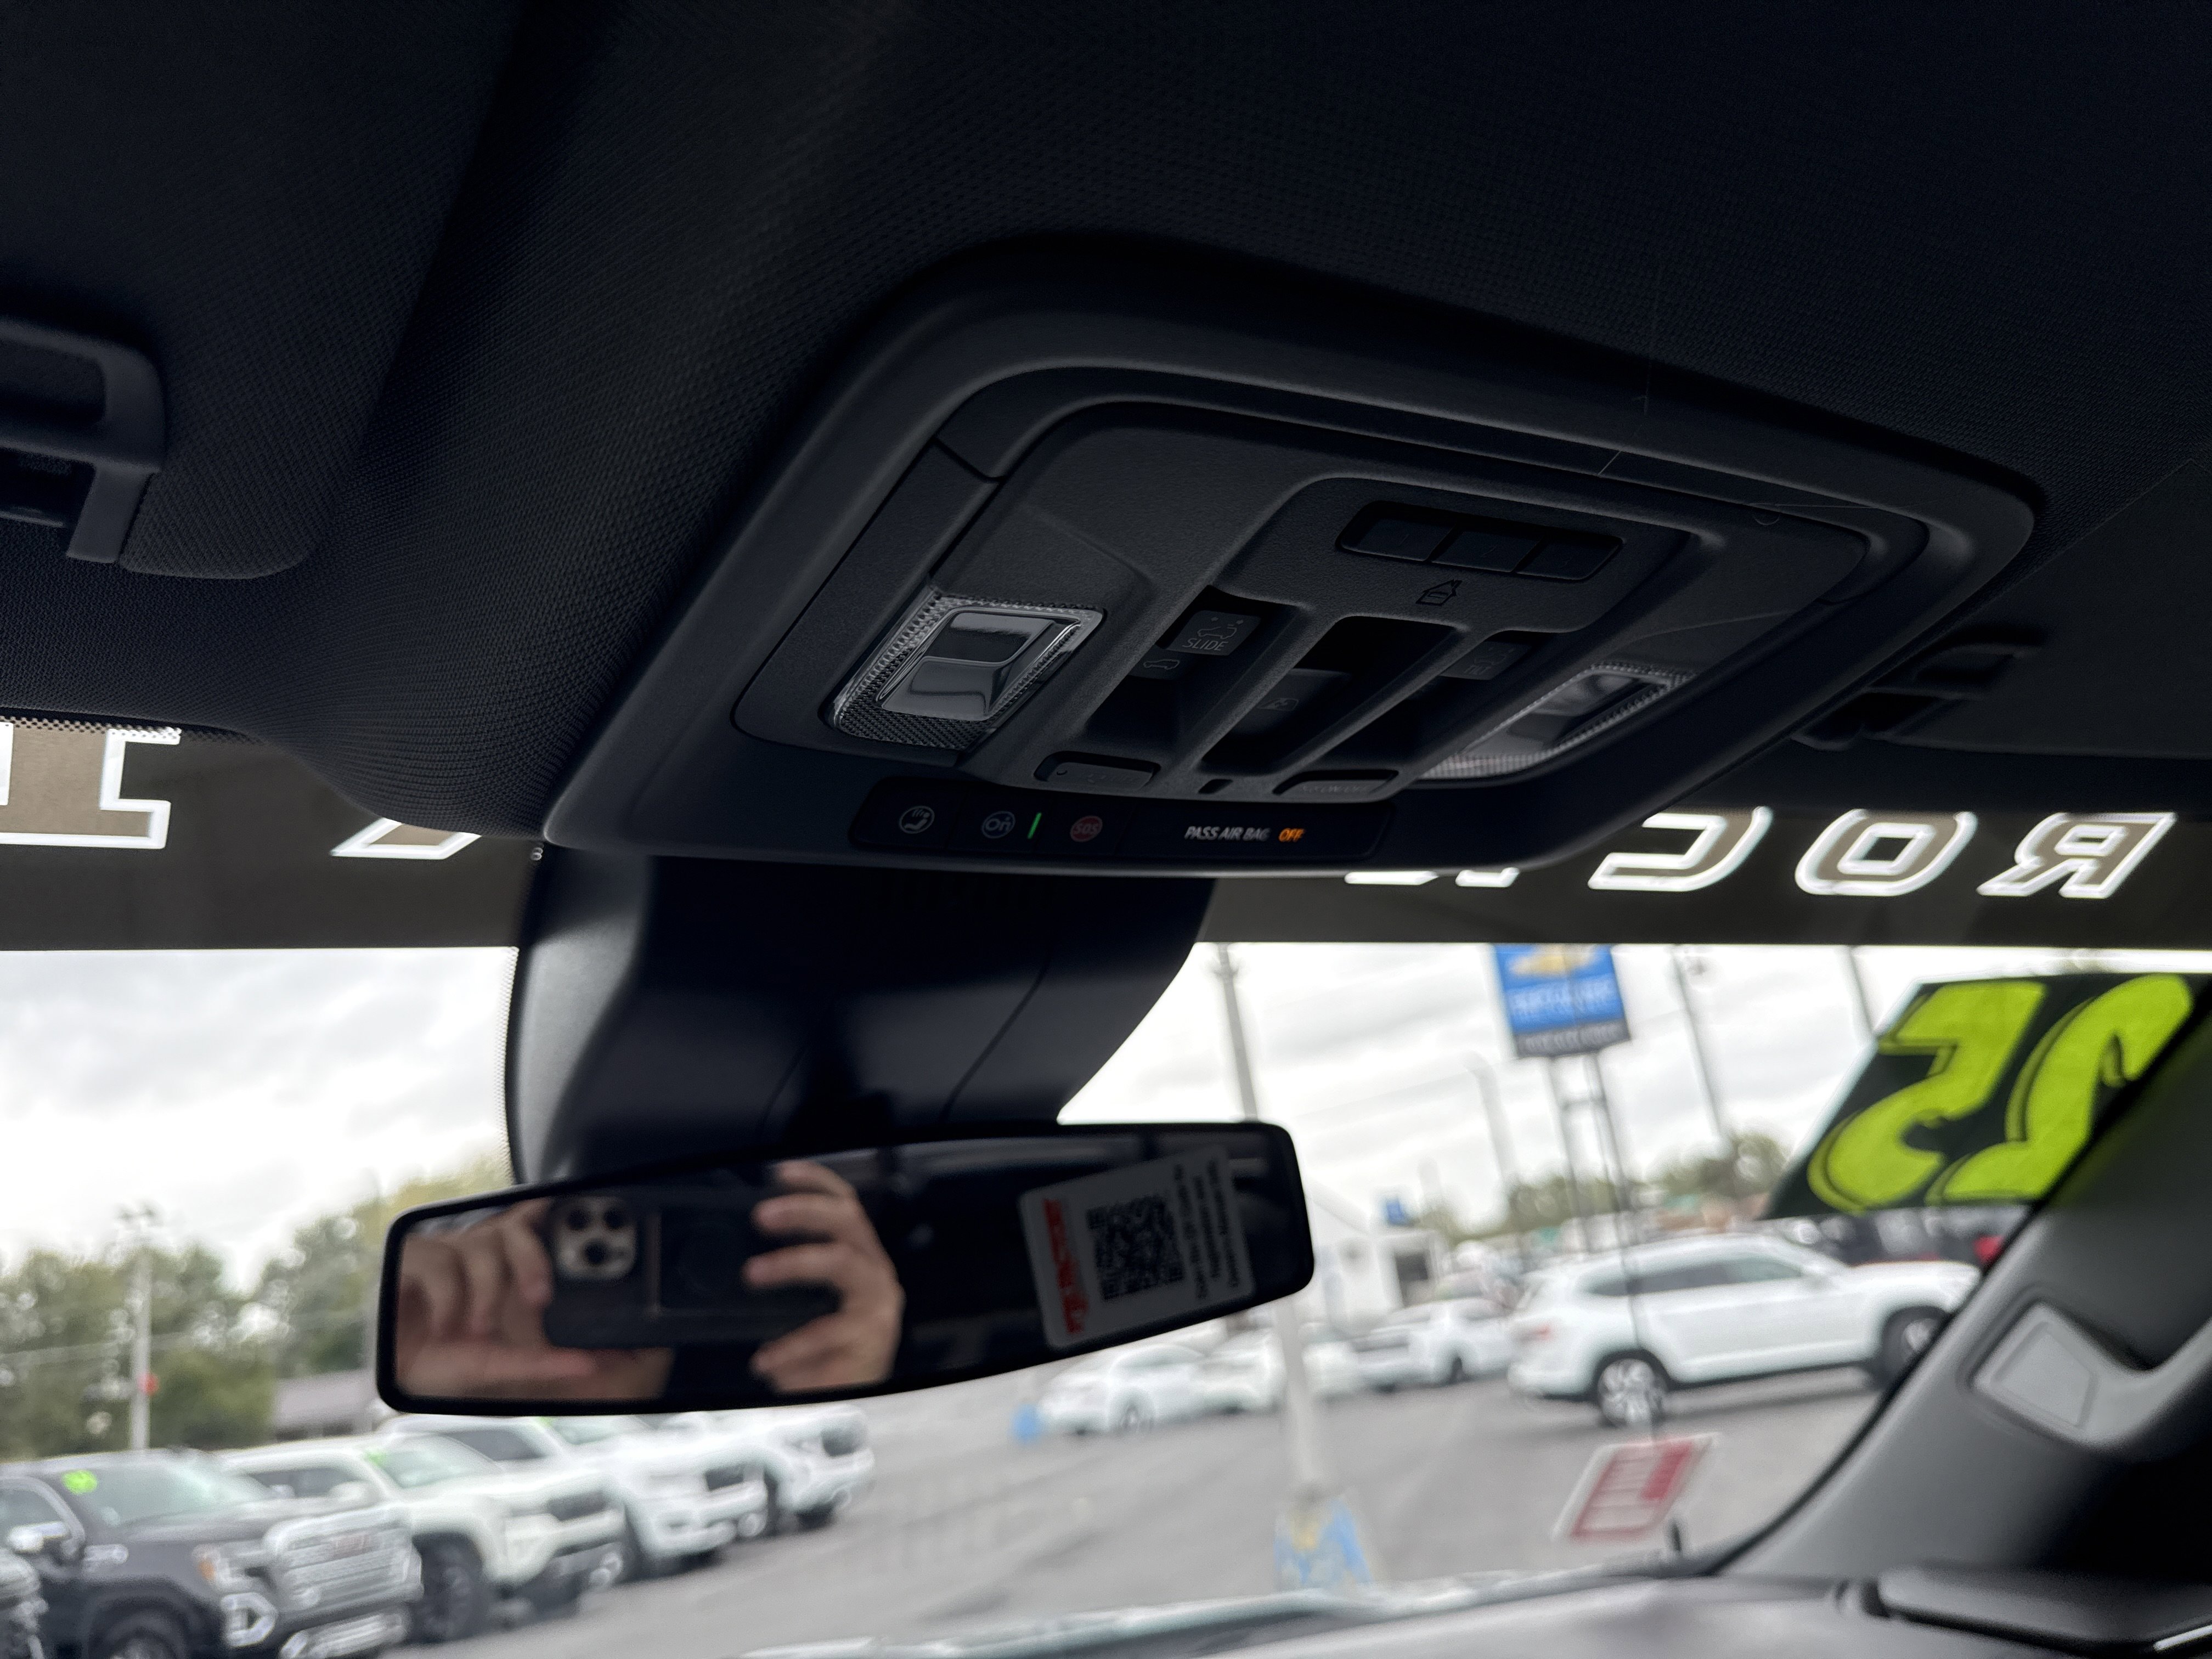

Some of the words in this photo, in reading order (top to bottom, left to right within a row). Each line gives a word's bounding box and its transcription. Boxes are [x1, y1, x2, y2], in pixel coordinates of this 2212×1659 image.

[1182, 637, 1228, 651] SLIDE
[1073, 823, 1099, 834] SOS
[1184, 825, 1220, 840] PASS
[1217, 826, 1244, 840] AIR
[1243, 827, 1272, 842] BAG
[1278, 827, 1306, 842] OFF
